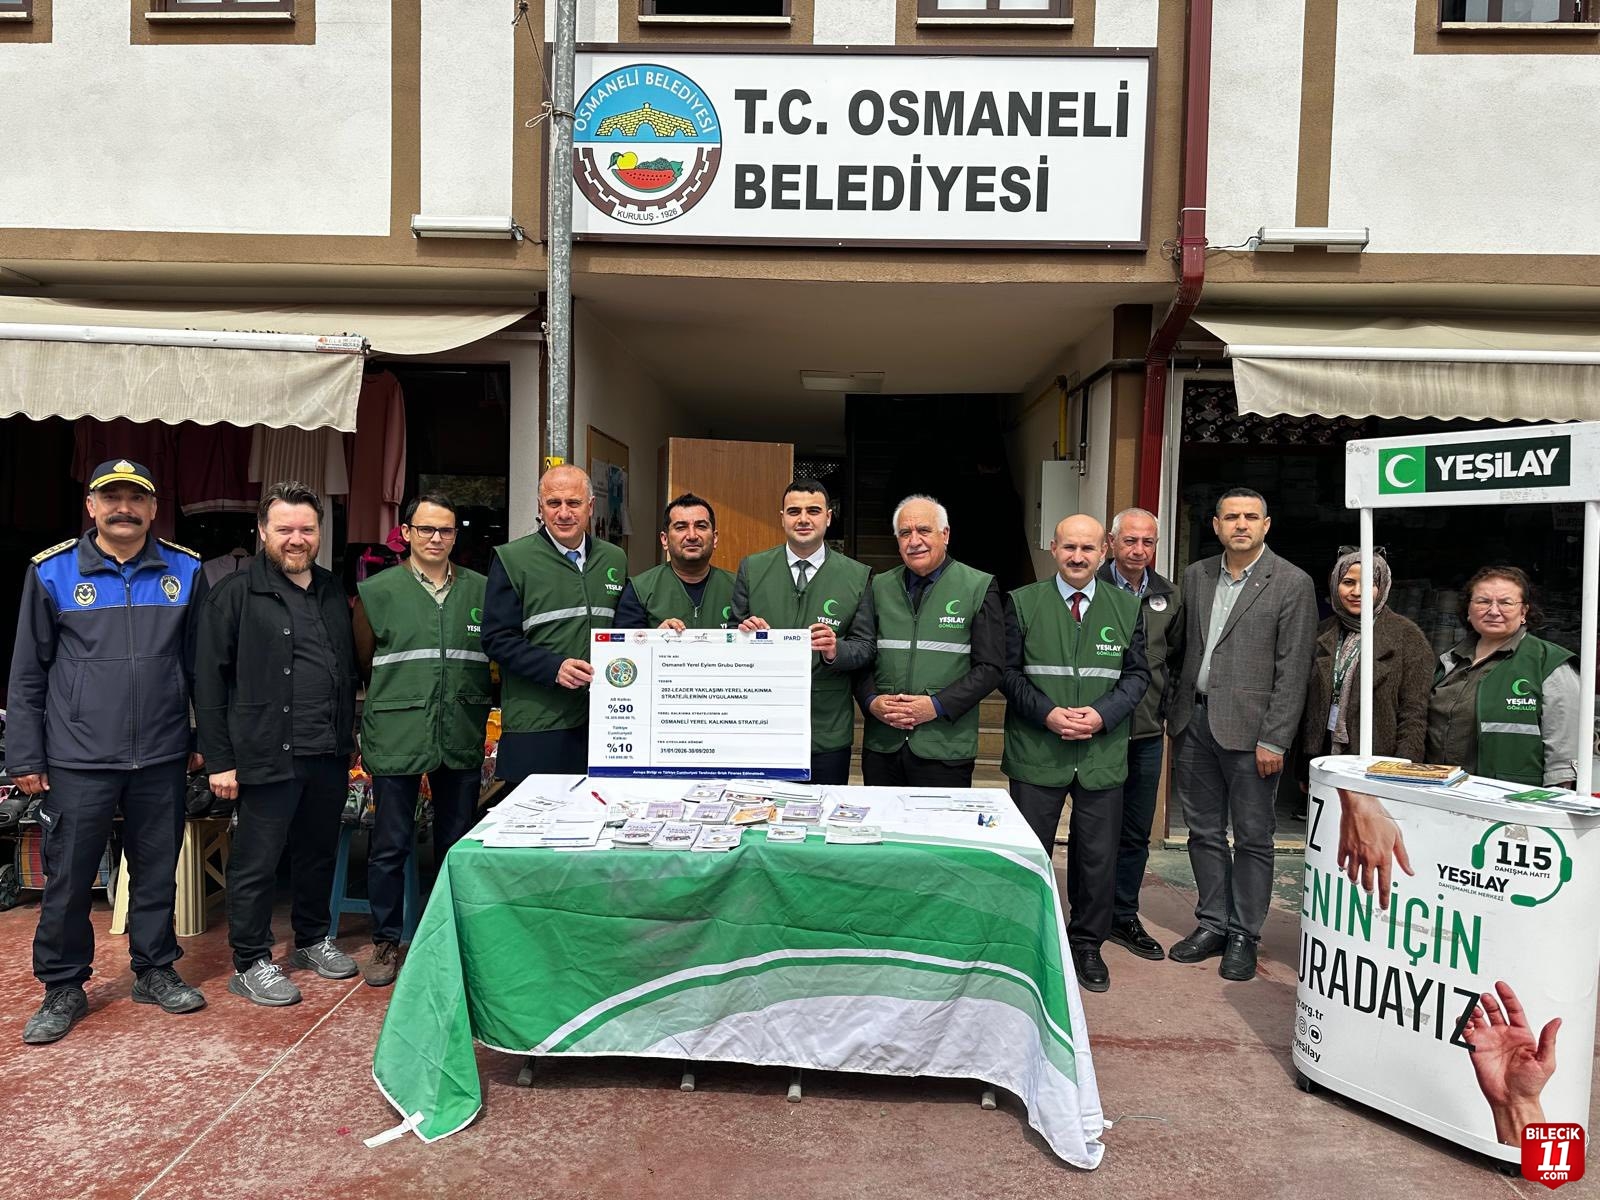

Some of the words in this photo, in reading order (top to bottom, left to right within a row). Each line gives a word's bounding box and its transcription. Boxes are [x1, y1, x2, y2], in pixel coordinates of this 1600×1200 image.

[574, 69, 639, 132] OSMANELİ
[645, 71, 717, 134] BELEDİYESİ
[734, 89, 828, 136] T.C.
[848, 80, 1129, 138] OSMANELİ
[734, 154, 1050, 212] BELEDİYESİ
[616, 209, 654, 222] KURULUŞ
[661, 208, 678, 219] 1926
[607, 704, 634, 713] %90
[606, 743, 633, 753] %10
[1496, 840, 1552, 871] 115
[1494, 865, 1529, 876] DANIŞMA
[1529, 870, 1551, 879] HATTI
[1388, 881, 1482, 976] İÇİN
